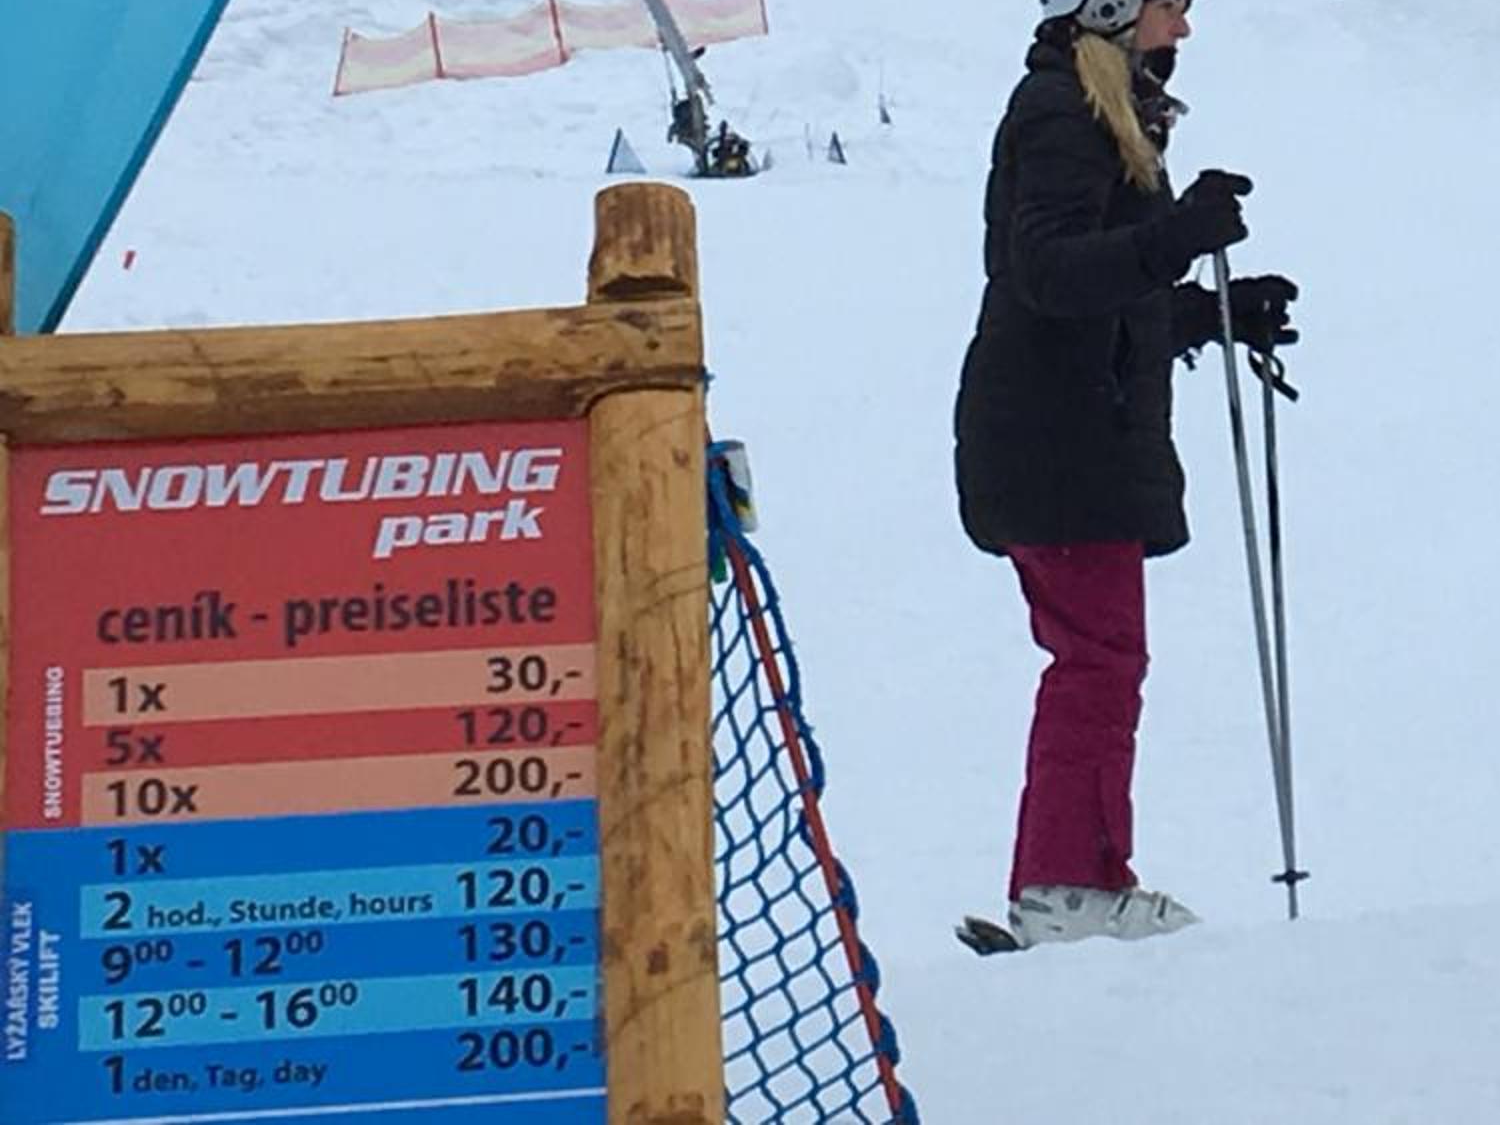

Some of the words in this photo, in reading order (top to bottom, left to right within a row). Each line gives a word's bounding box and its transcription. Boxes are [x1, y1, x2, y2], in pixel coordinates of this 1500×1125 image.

[40, 448, 562, 515] SNOWTUBING
[372, 499, 545, 558] park
[98, 589, 237, 644] ceník
[284, 579, 558, 647] preiseliste
[107, 676, 167, 713] 1x
[486, 655, 583, 696] 30,-
[105, 729, 165, 765] 5x
[455, 706, 583, 746] 120,-
[107, 778, 199, 817] 10x
[453, 756, 583, 798] 200,-
[106, 839, 166, 876] 1x
[486, 815, 585, 857] 20,-
[12, 901, 33, 955] VLEK
[103, 890, 133, 931] 2
[229, 896, 344, 923] Stunde,
[350, 893, 433, 916] hours
[456, 867, 586, 910] 120,-
[458, 920, 586, 963] 130,-
[38, 930, 62, 1030] SKILIFT
[459, 973, 588, 1019] 140,-
[103, 1055, 125, 1095] 1
[133, 1067, 198, 1093] den,
[274, 1058, 328, 1087] day
[456, 1028, 588, 1072] 200,-
